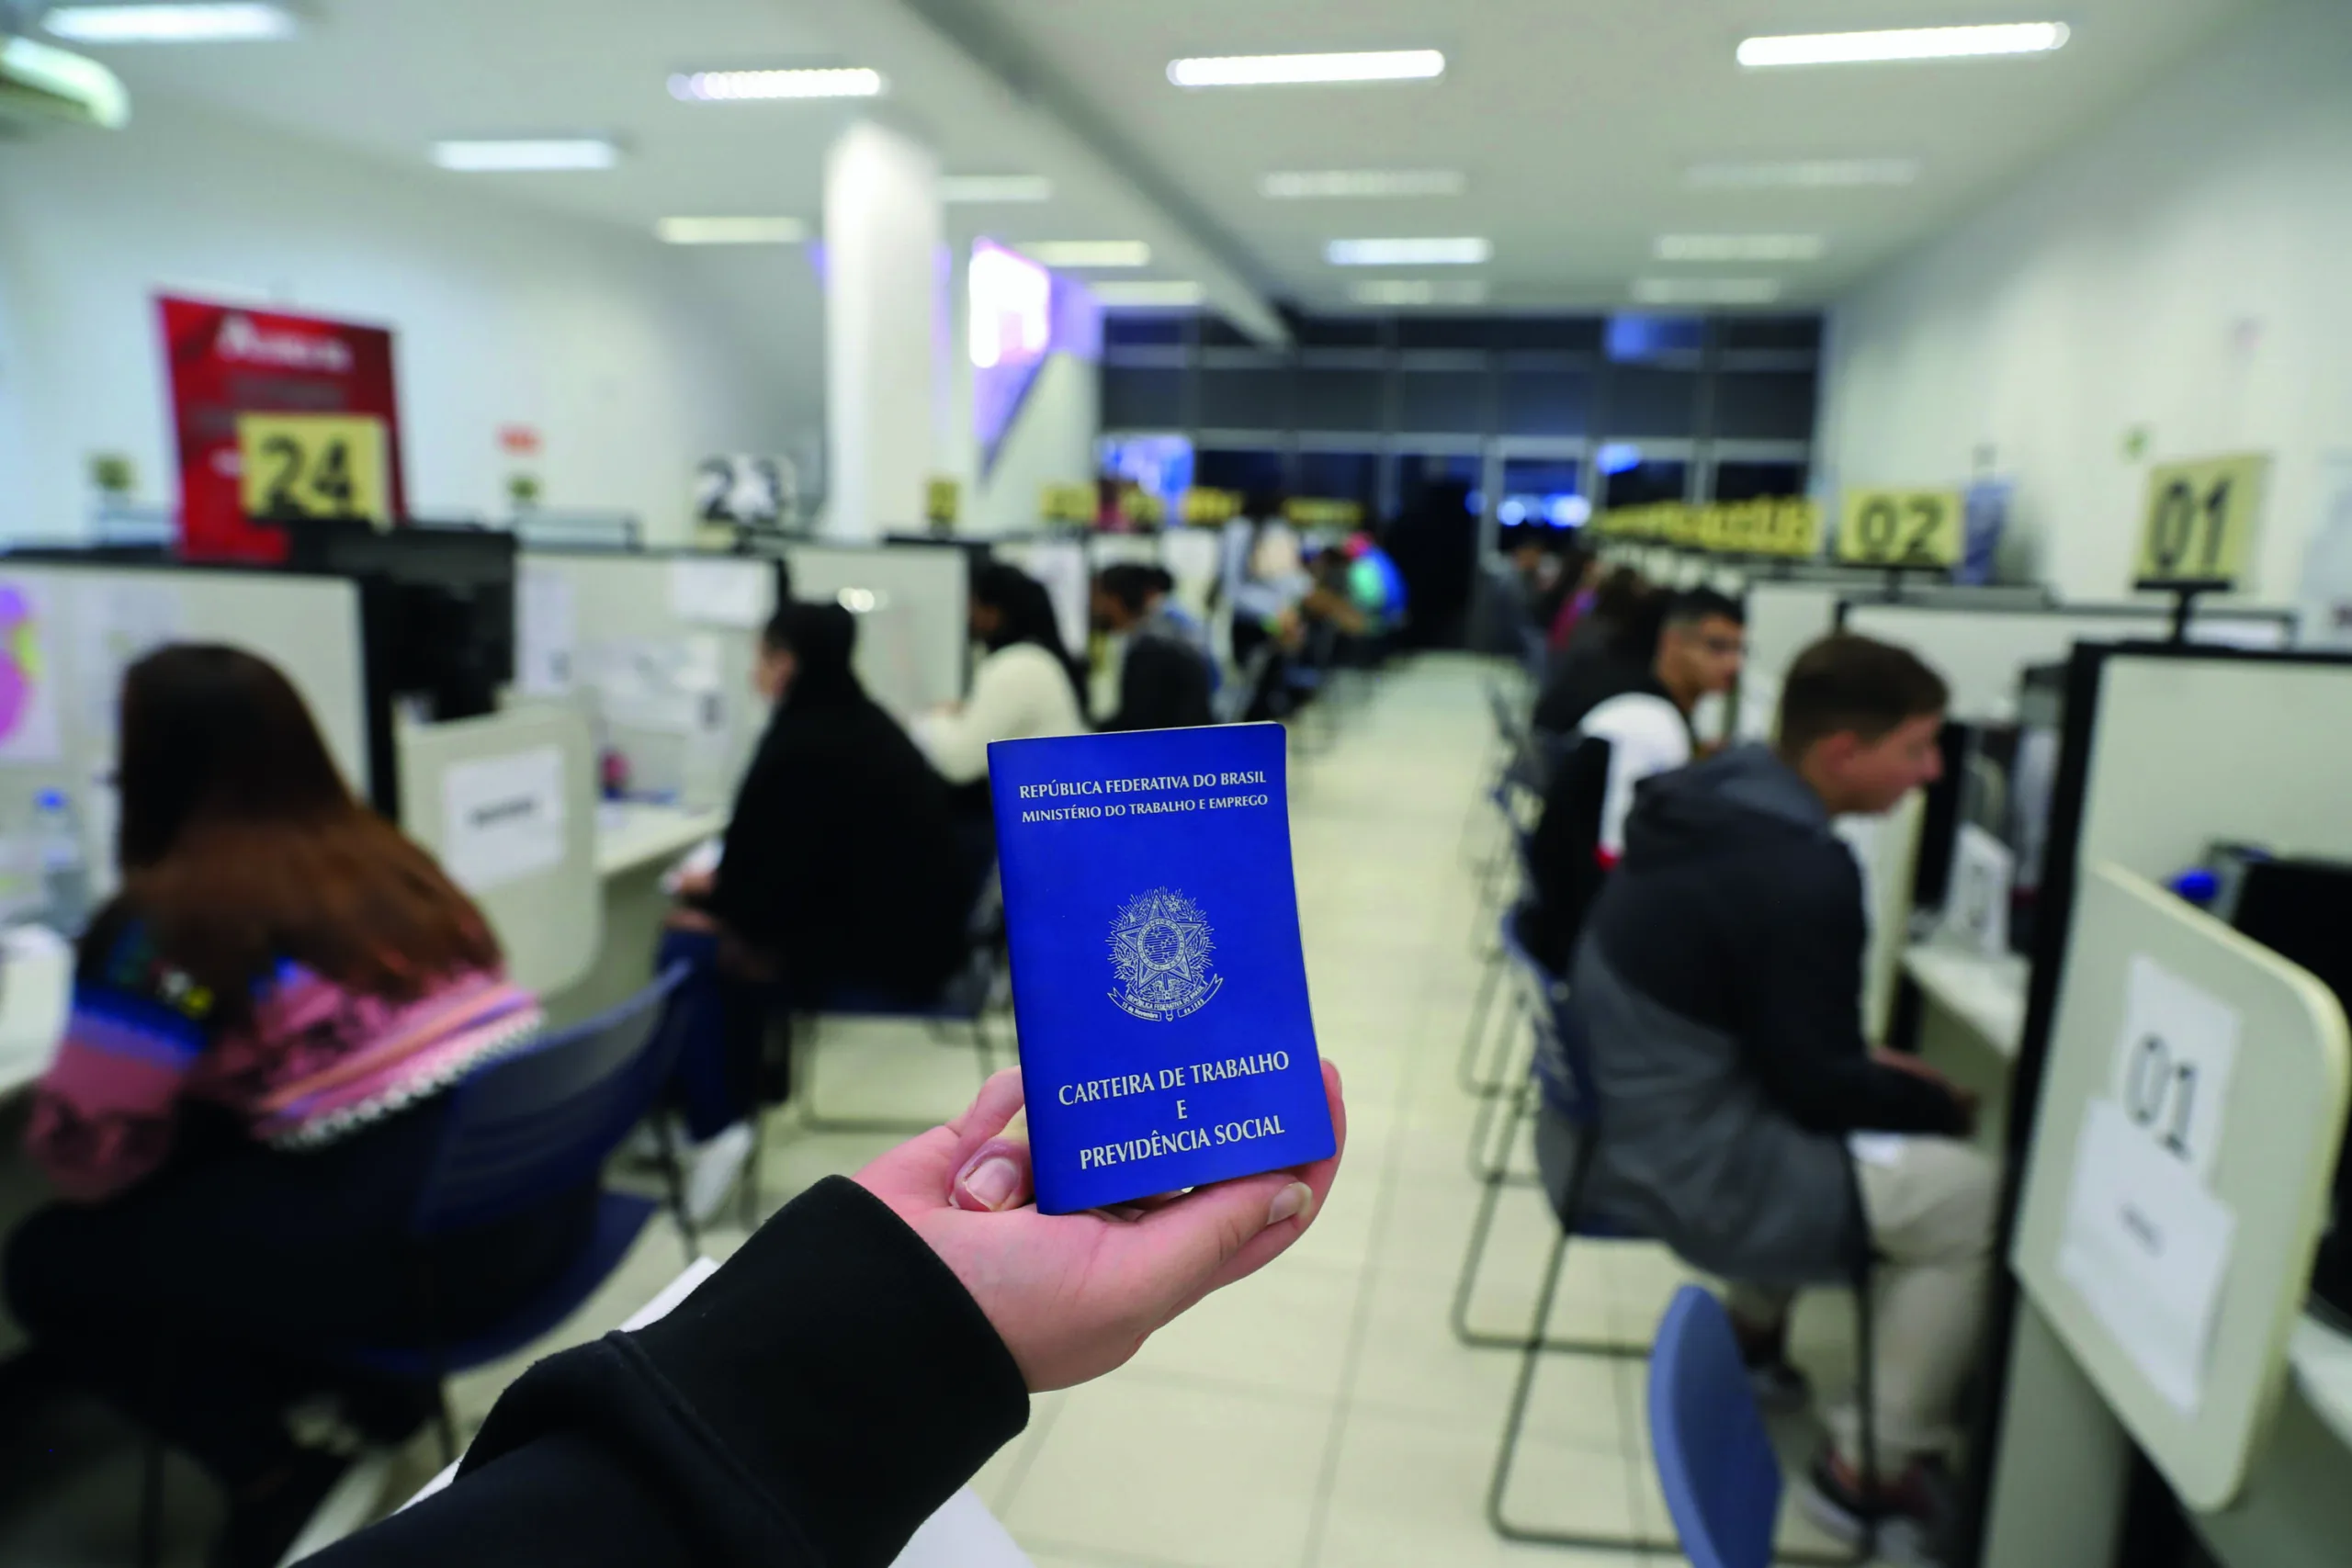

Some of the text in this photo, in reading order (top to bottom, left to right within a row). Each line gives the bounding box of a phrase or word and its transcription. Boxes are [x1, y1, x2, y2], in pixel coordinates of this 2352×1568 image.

[258, 434, 353, 518] 24
[1857, 494, 1944, 563] 02
[2150, 476, 2233, 579] 01
[1019, 771, 1267, 798] REPÚBLICA FEDERATIVA DO BRASIL
[1022, 794, 1268, 823] MINISTÉRIO DO TRABALHO E EMPREGO
[1058, 1050, 1290, 1106] CARTEIRA DE TRABALHO
[2124, 1032, 2198, 1164] 01
[1176, 1100, 1188, 1120] E
[1080, 1114, 1285, 1170] PREVIDÊNCIA SOCIAL
